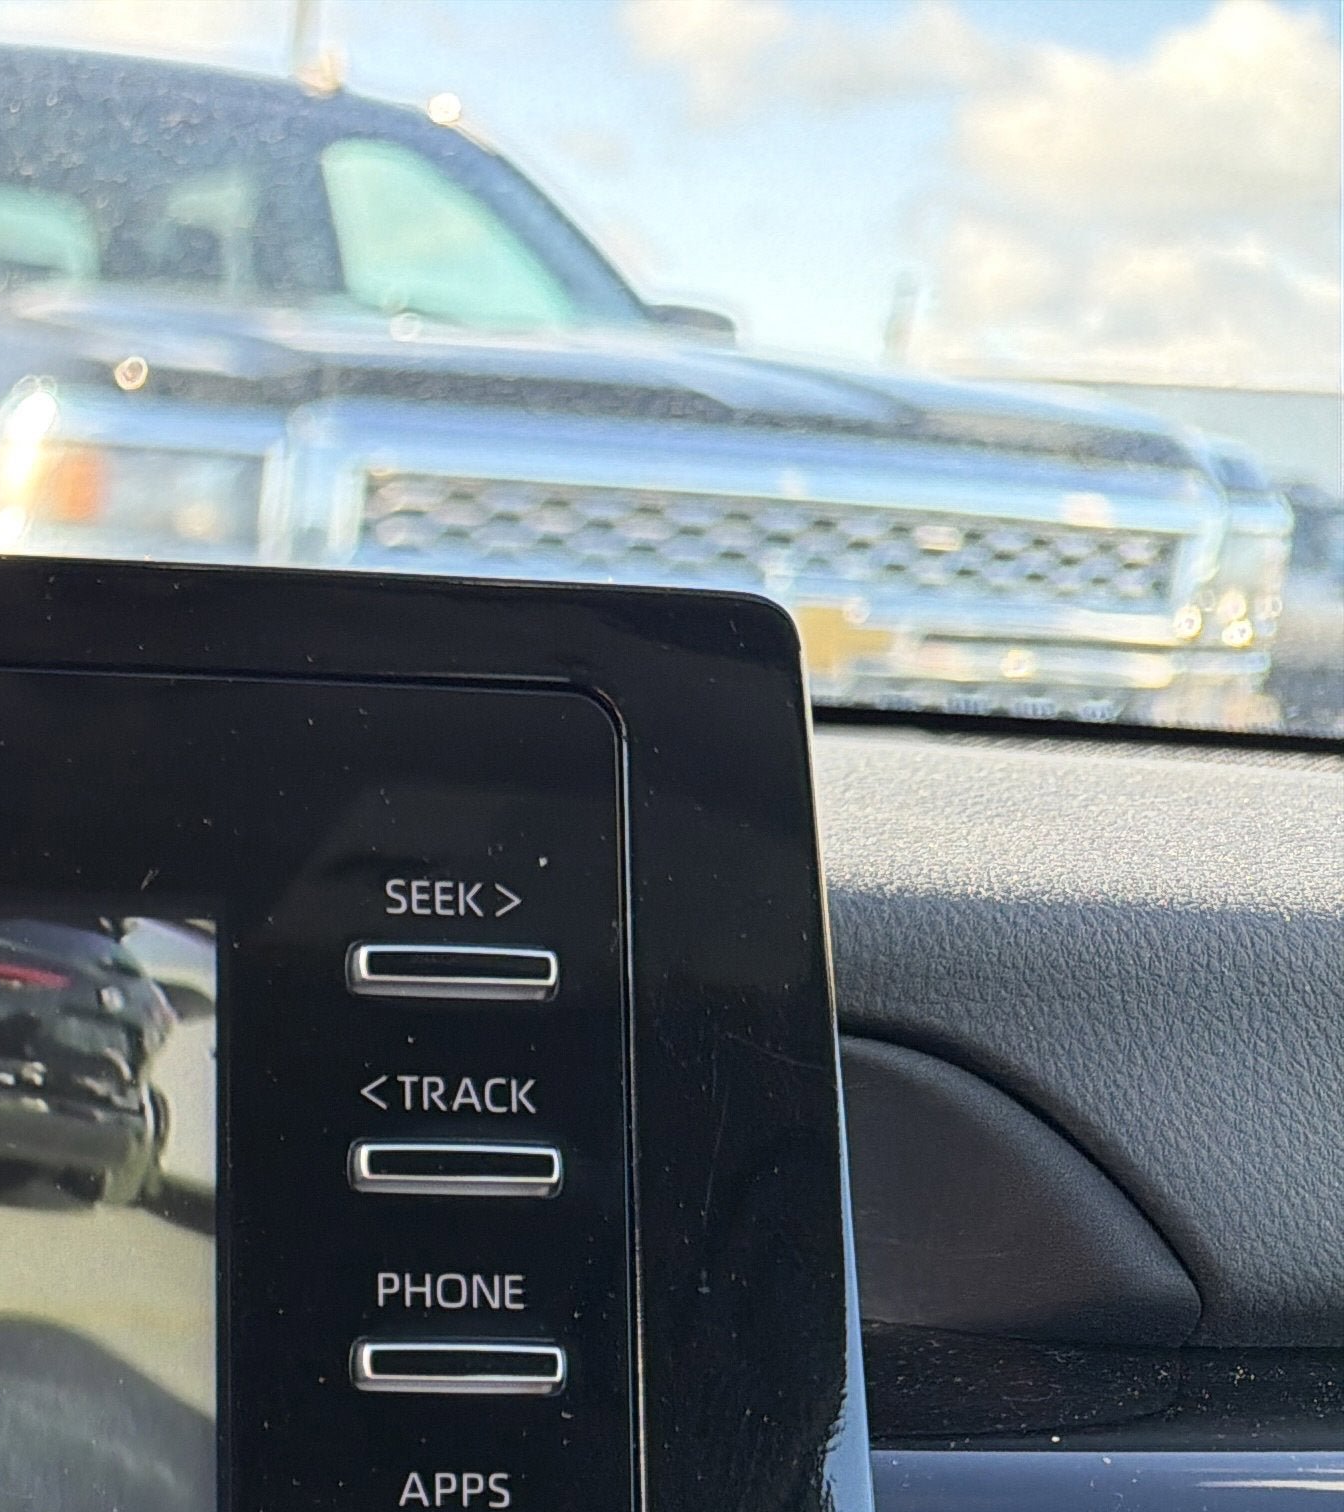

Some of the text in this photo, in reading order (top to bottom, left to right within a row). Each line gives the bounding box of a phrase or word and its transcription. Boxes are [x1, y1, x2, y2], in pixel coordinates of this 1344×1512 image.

[385, 879, 484, 917] SEEK
[377, 1272, 526, 1310] PHONE
[398, 1472, 511, 1508] APPS
